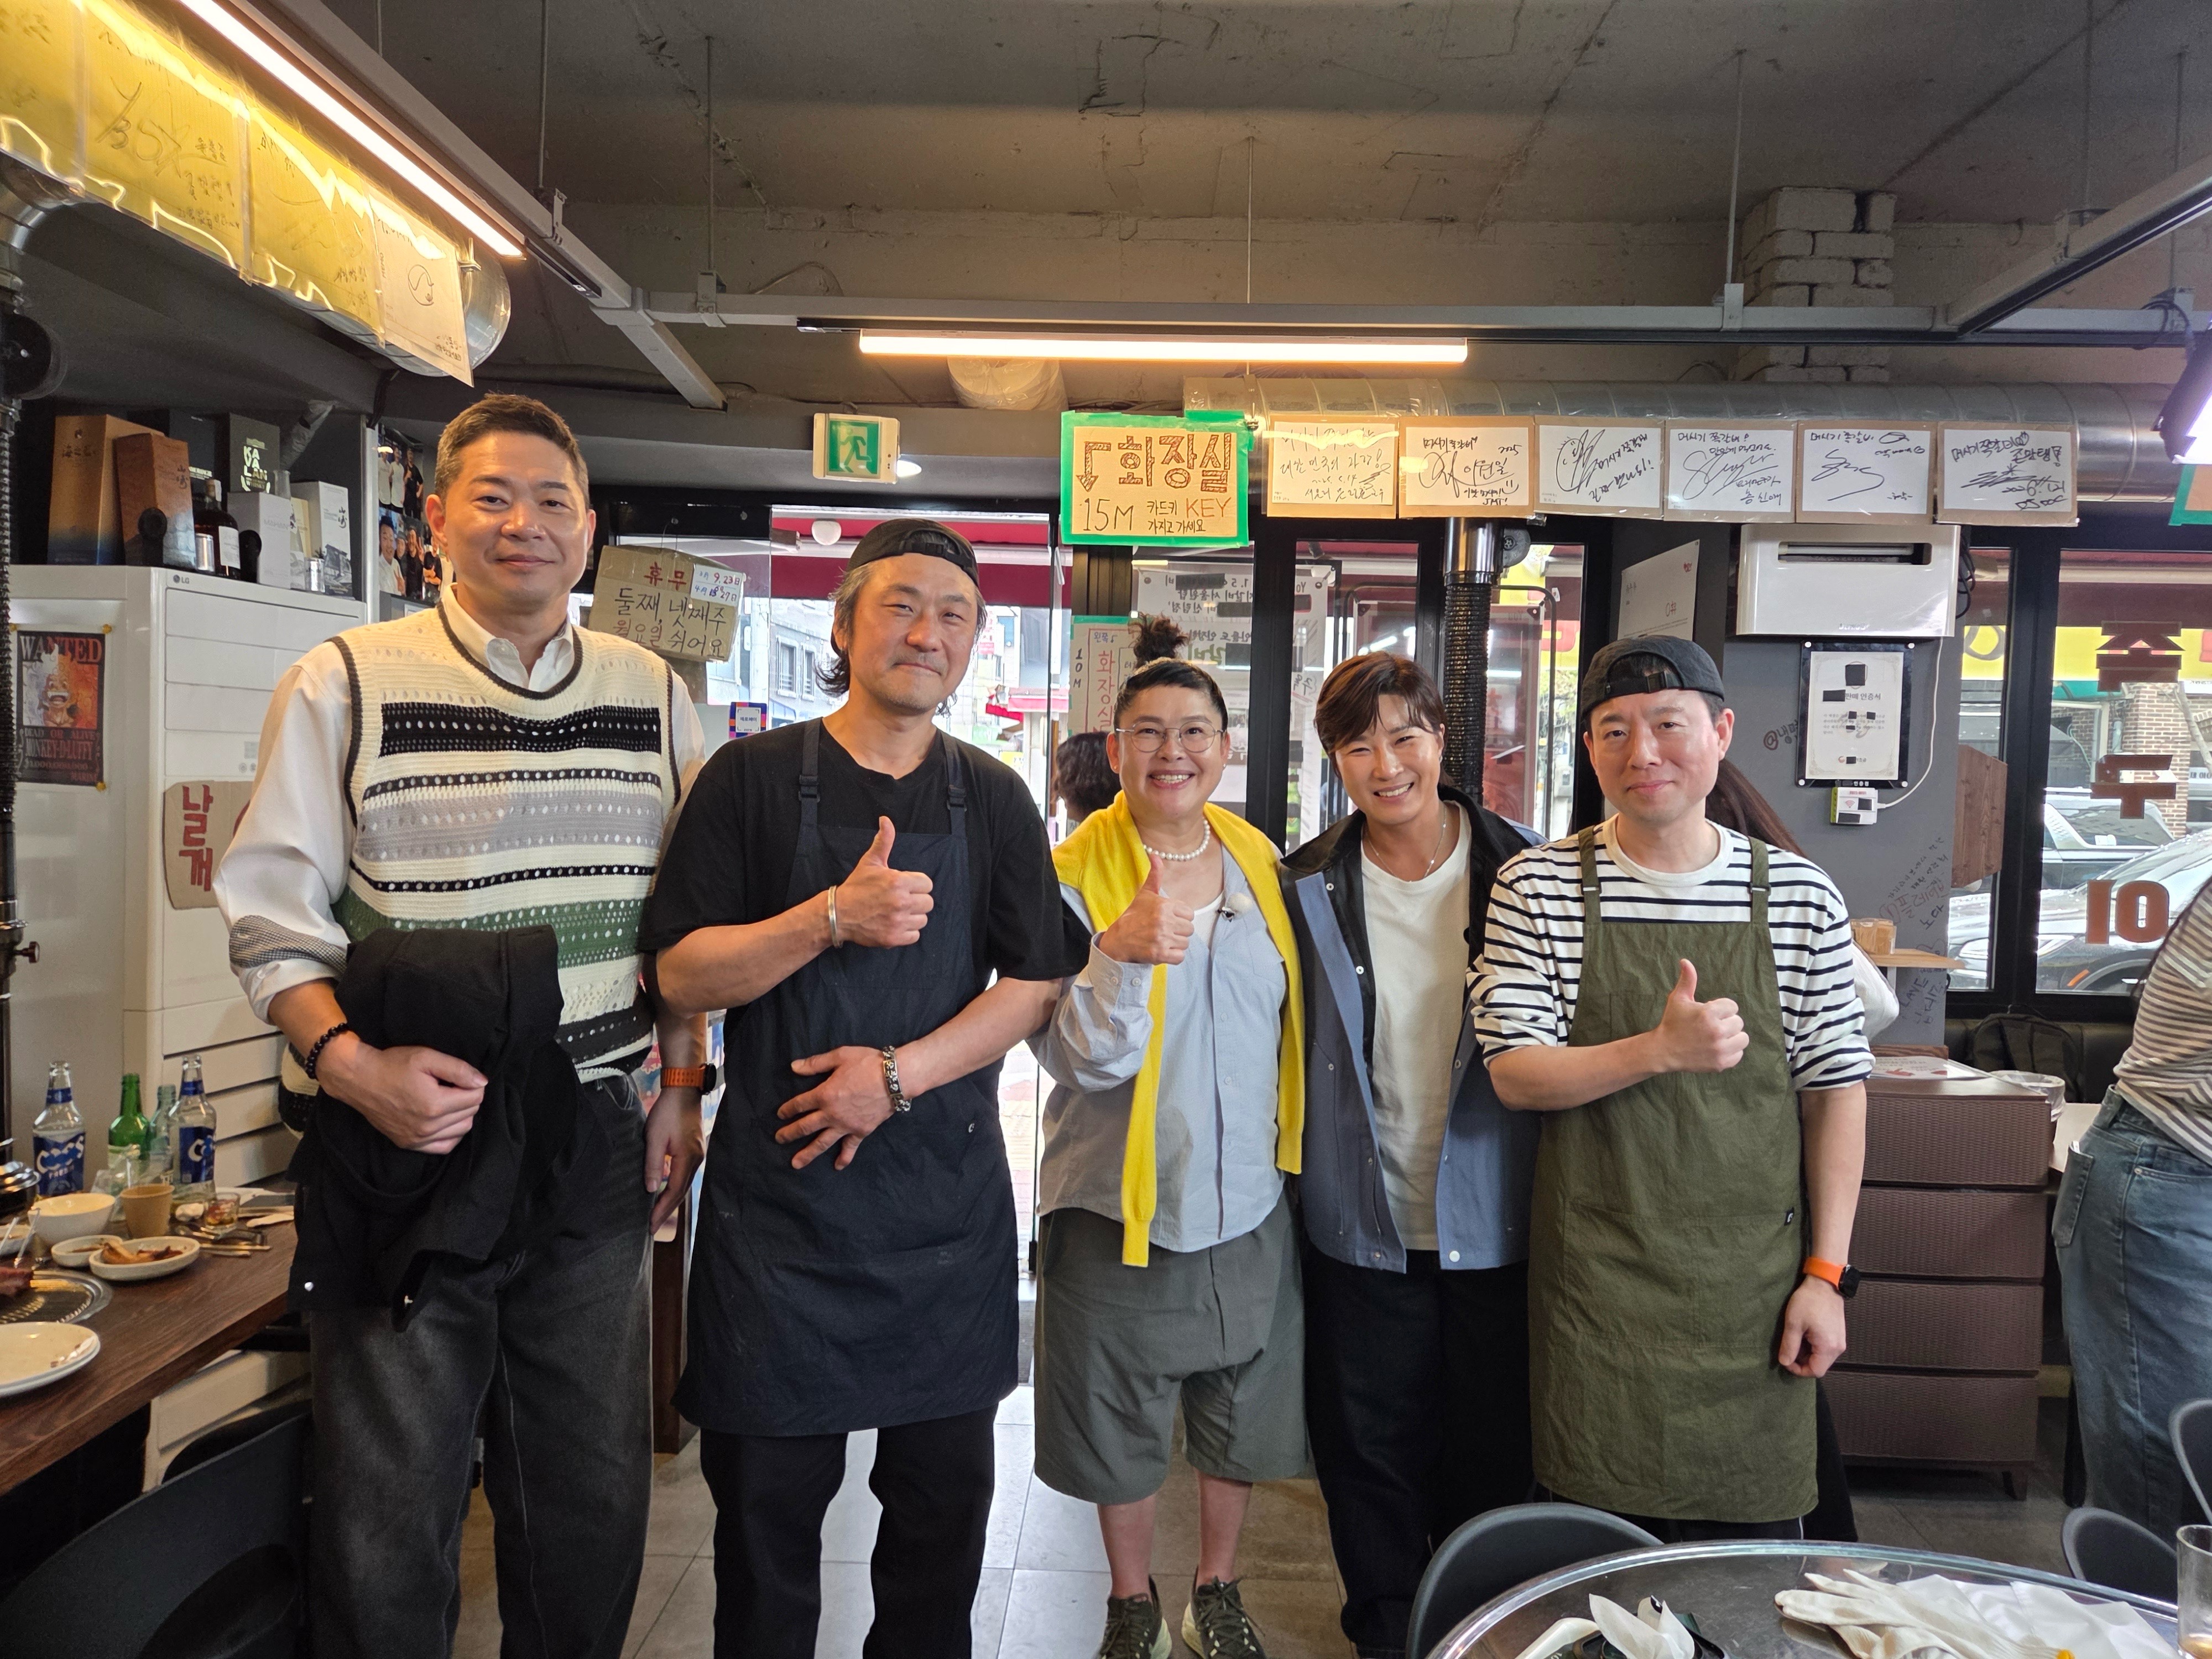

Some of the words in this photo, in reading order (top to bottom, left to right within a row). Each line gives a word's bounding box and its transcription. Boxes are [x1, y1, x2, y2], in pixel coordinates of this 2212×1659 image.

[1118, 433, 1232, 493] 화장실
[1147, 499, 1177, 515] 카드키
[1186, 497, 1232, 518] KEY
[1148, 518, 1173, 535] 가지고
[1176, 519, 1206, 534] 가세요
[667, 630, 725, 659] 쉬어요
[1094, 632, 1108, 643] 왼쪽
[19, 636, 102, 662] WANTED
[1860, 692, 1881, 701] 인증서
[24, 728, 44, 737] DEAD
[179, 784, 213, 891] 날개
